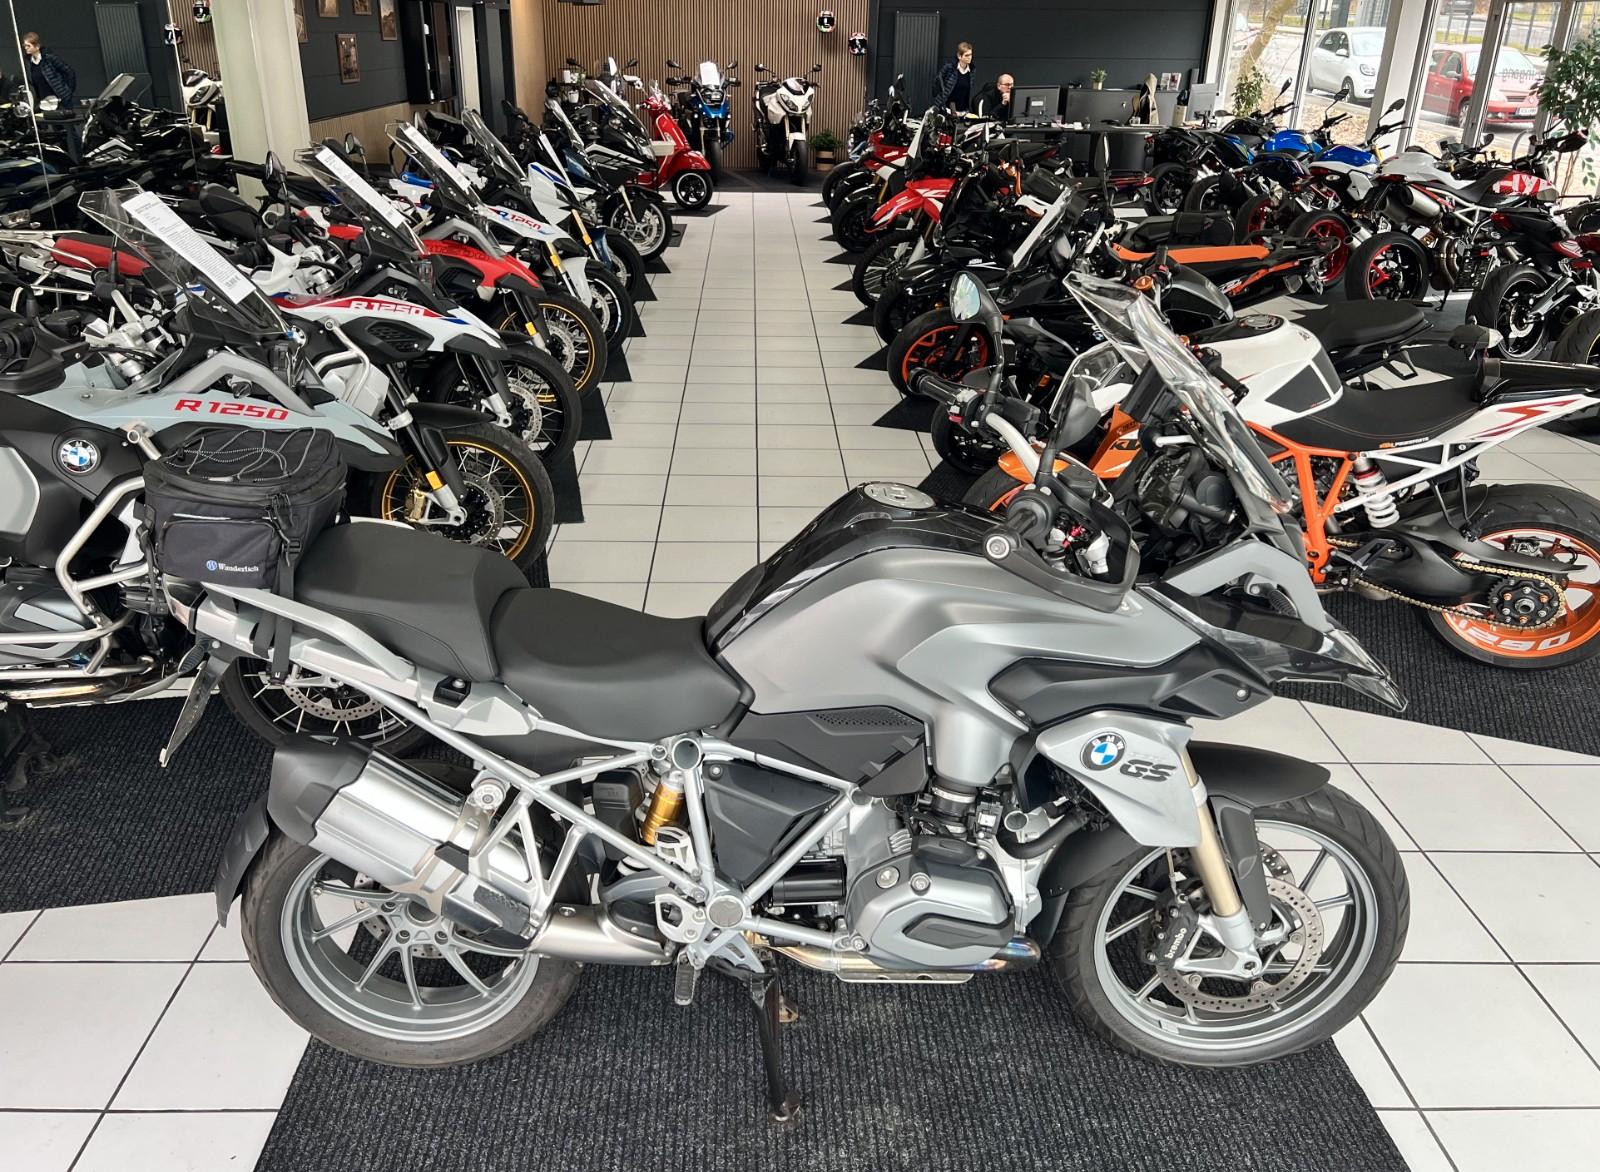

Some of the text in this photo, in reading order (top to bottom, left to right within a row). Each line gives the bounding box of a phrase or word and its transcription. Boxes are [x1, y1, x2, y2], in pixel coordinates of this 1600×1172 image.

[208, 401, 289, 420] 1250
[1110, 439, 1141, 450] KT
[1119, 759, 1177, 782] GS
[1164, 928, 1188, 959] brembo
